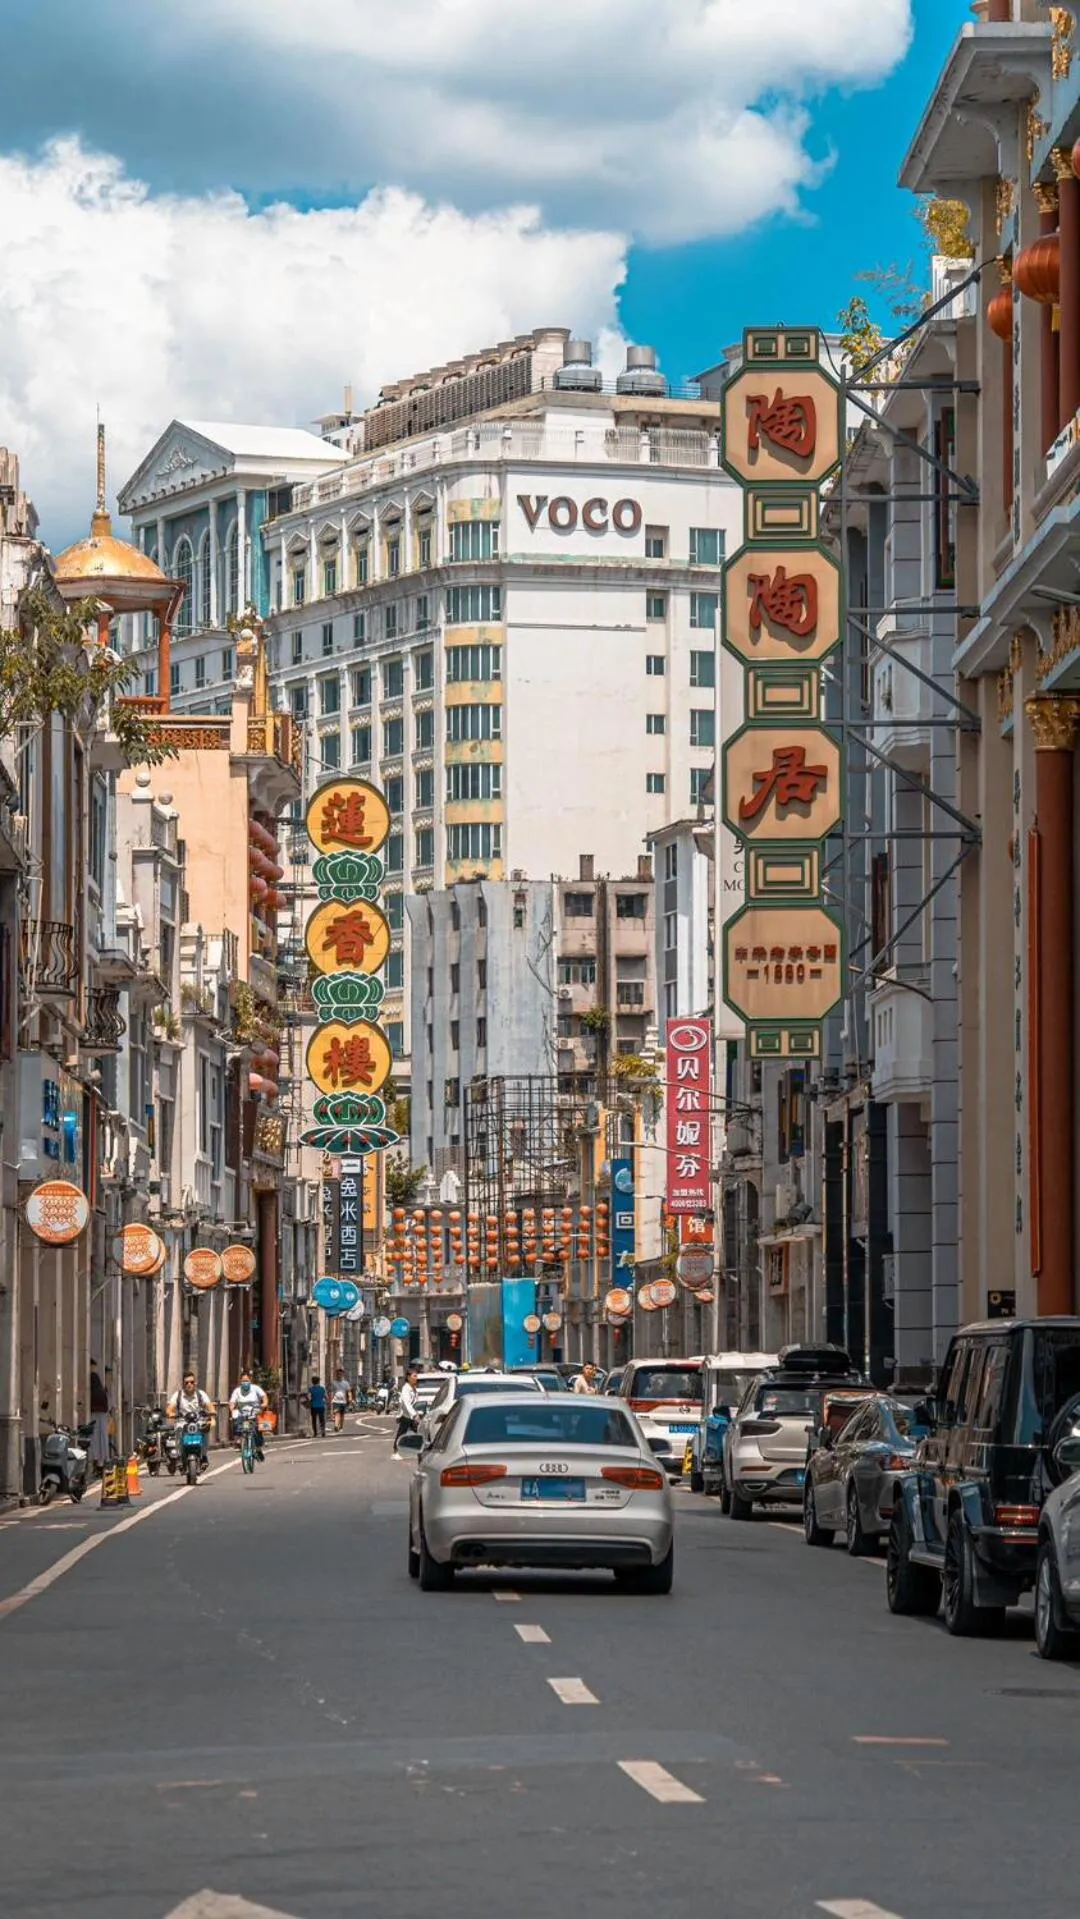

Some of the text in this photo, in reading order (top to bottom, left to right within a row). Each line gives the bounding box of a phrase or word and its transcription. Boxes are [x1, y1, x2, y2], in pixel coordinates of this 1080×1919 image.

[516, 494, 643, 533] VOCO
[738, 387, 828, 820] 陶陶居
[320, 791, 376, 1087] 蓮香樓
[675, 1056, 701, 1178] 贝尔妮芬
